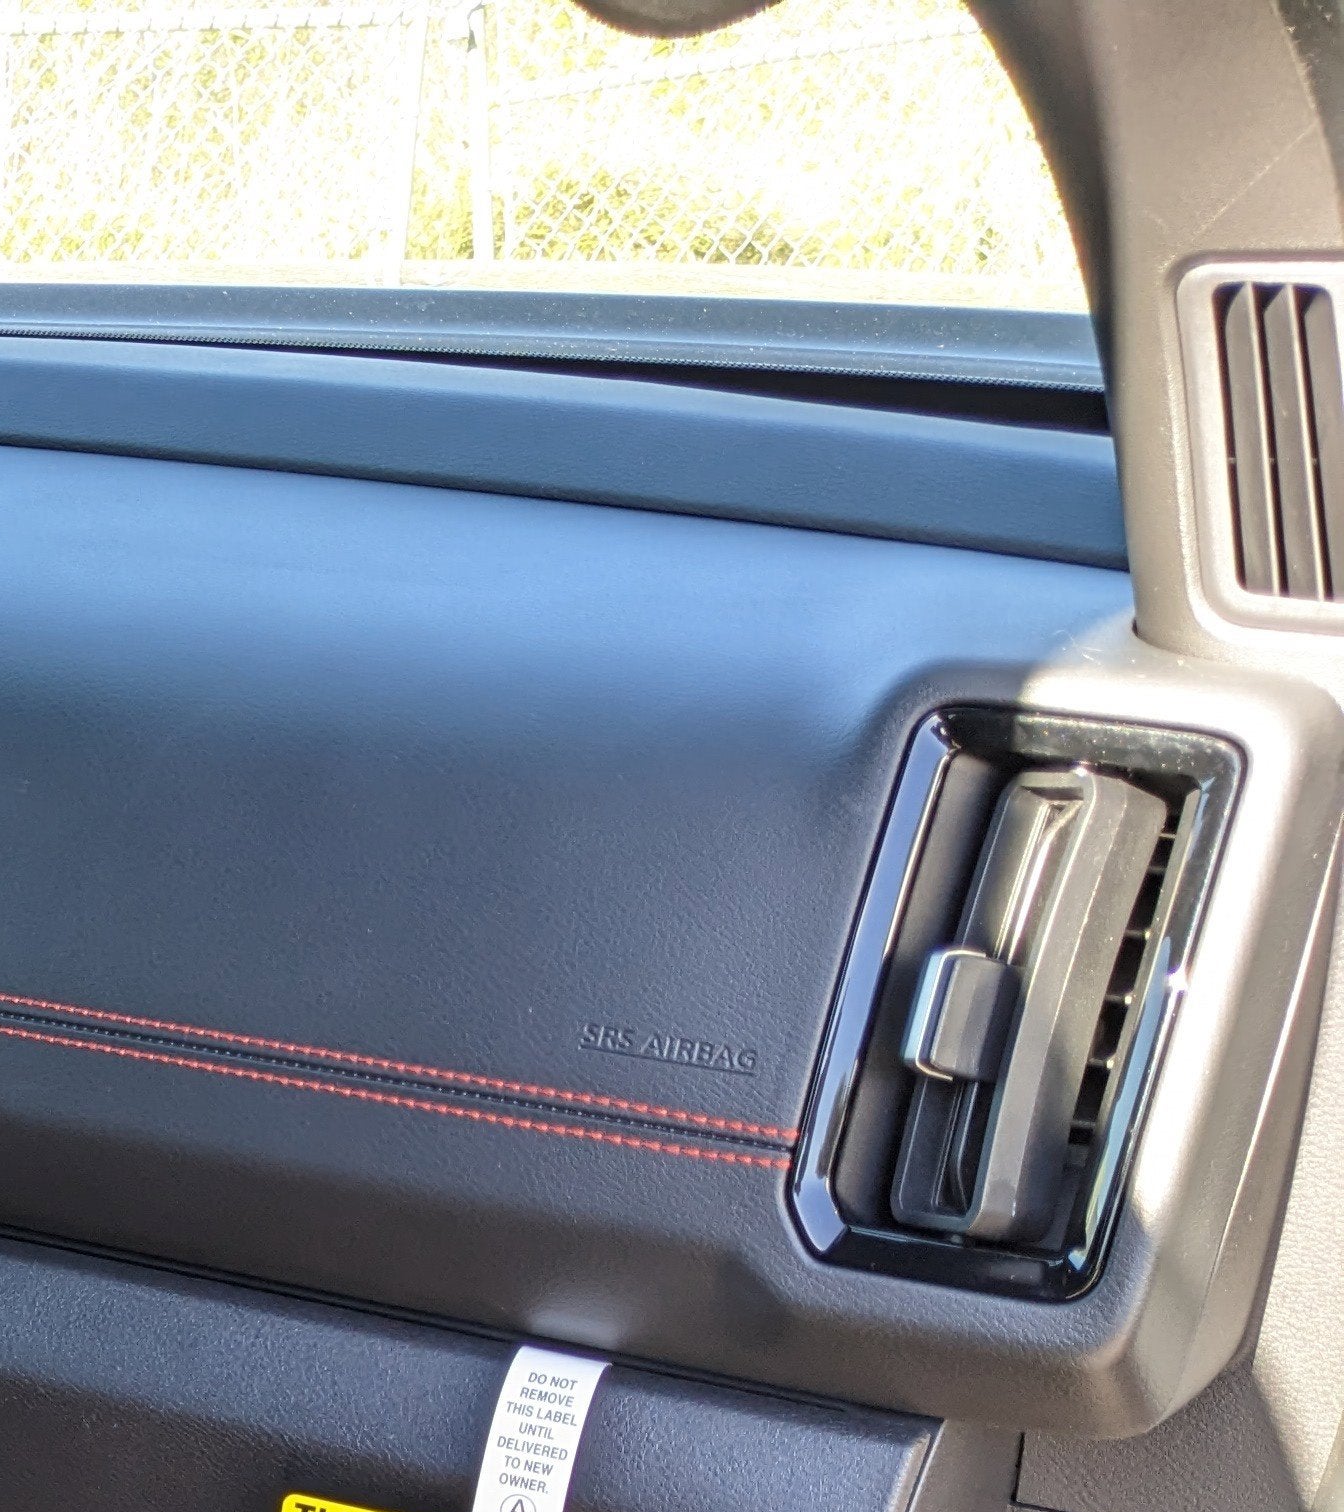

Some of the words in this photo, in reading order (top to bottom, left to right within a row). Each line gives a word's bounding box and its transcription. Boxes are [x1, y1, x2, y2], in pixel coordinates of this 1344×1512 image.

[580, 1023, 635, 1050] SRS
[641, 1033, 758, 1070] AIRBAG
[527, 1371, 547, 1384] DO
[549, 1375, 578, 1390] NOT
[519, 1386, 574, 1407] REMOVE
[506, 1400, 533, 1417] THIS
[536, 1407, 576, 1426] LABEL
[518, 1421, 554, 1440] UNTIL
[496, 1435, 568, 1460] DELIVERED
[504, 1454, 520, 1469] TO
[523, 1459, 553, 1475] NEW
[498, 1472, 549, 1494] OWNER.
